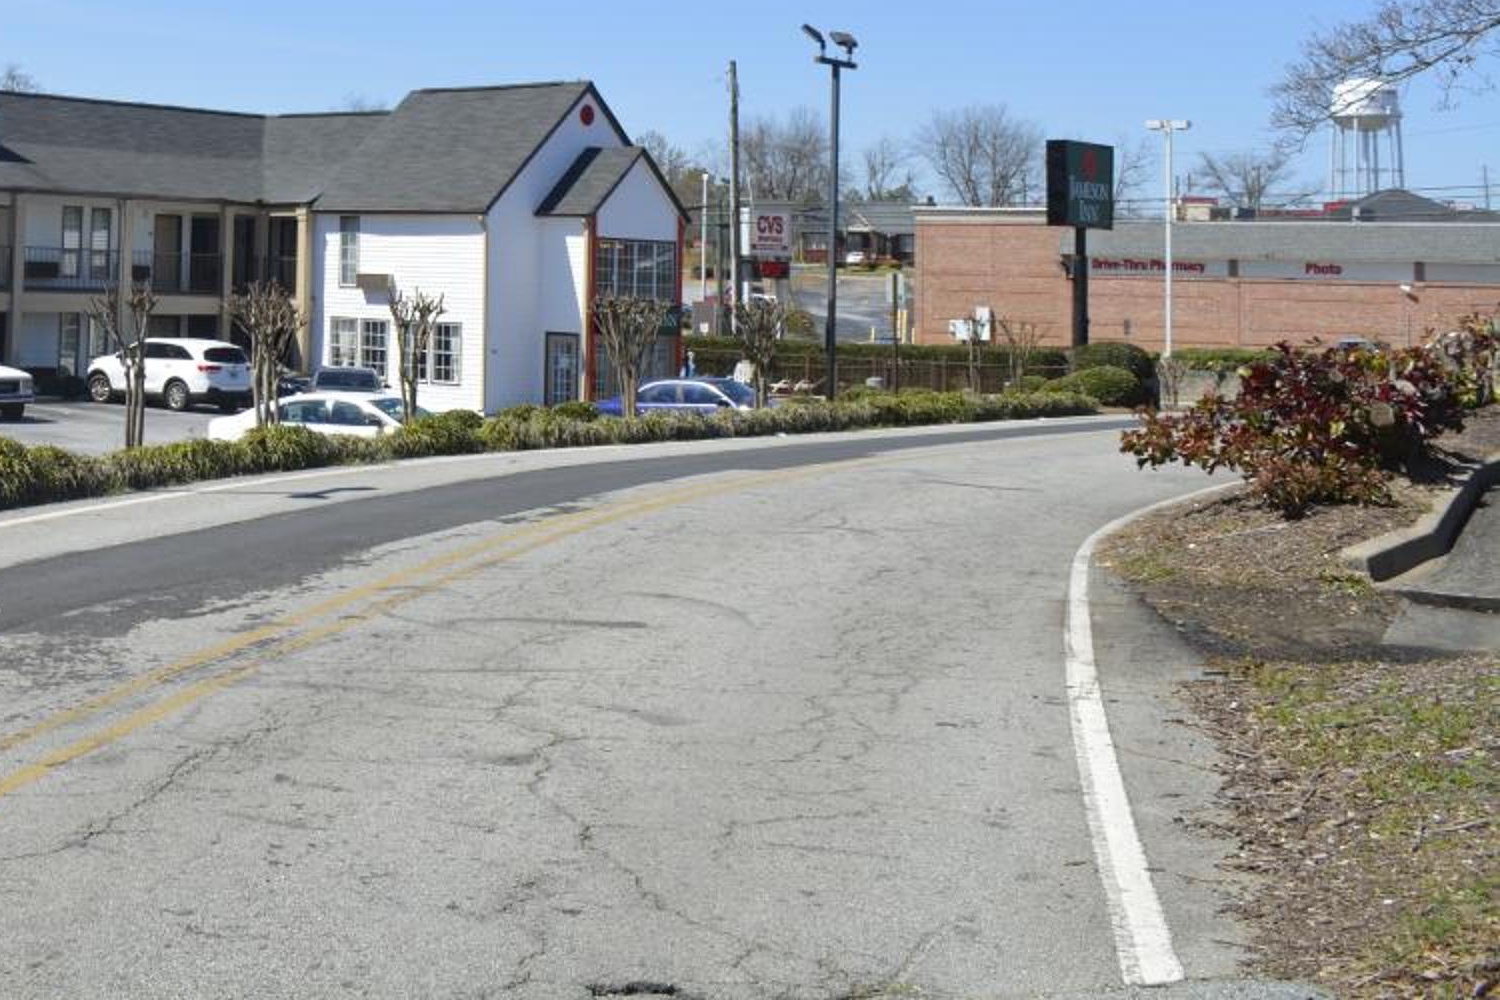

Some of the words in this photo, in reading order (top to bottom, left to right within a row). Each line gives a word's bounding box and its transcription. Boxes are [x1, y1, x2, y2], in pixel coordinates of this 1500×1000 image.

[757, 215, 784, 234] CVS
[1091, 258, 1149, 271] Drive-Thru
[1150, 258, 1205, 273] Phrmacy
[1305, 263, 1342, 275] Photo
